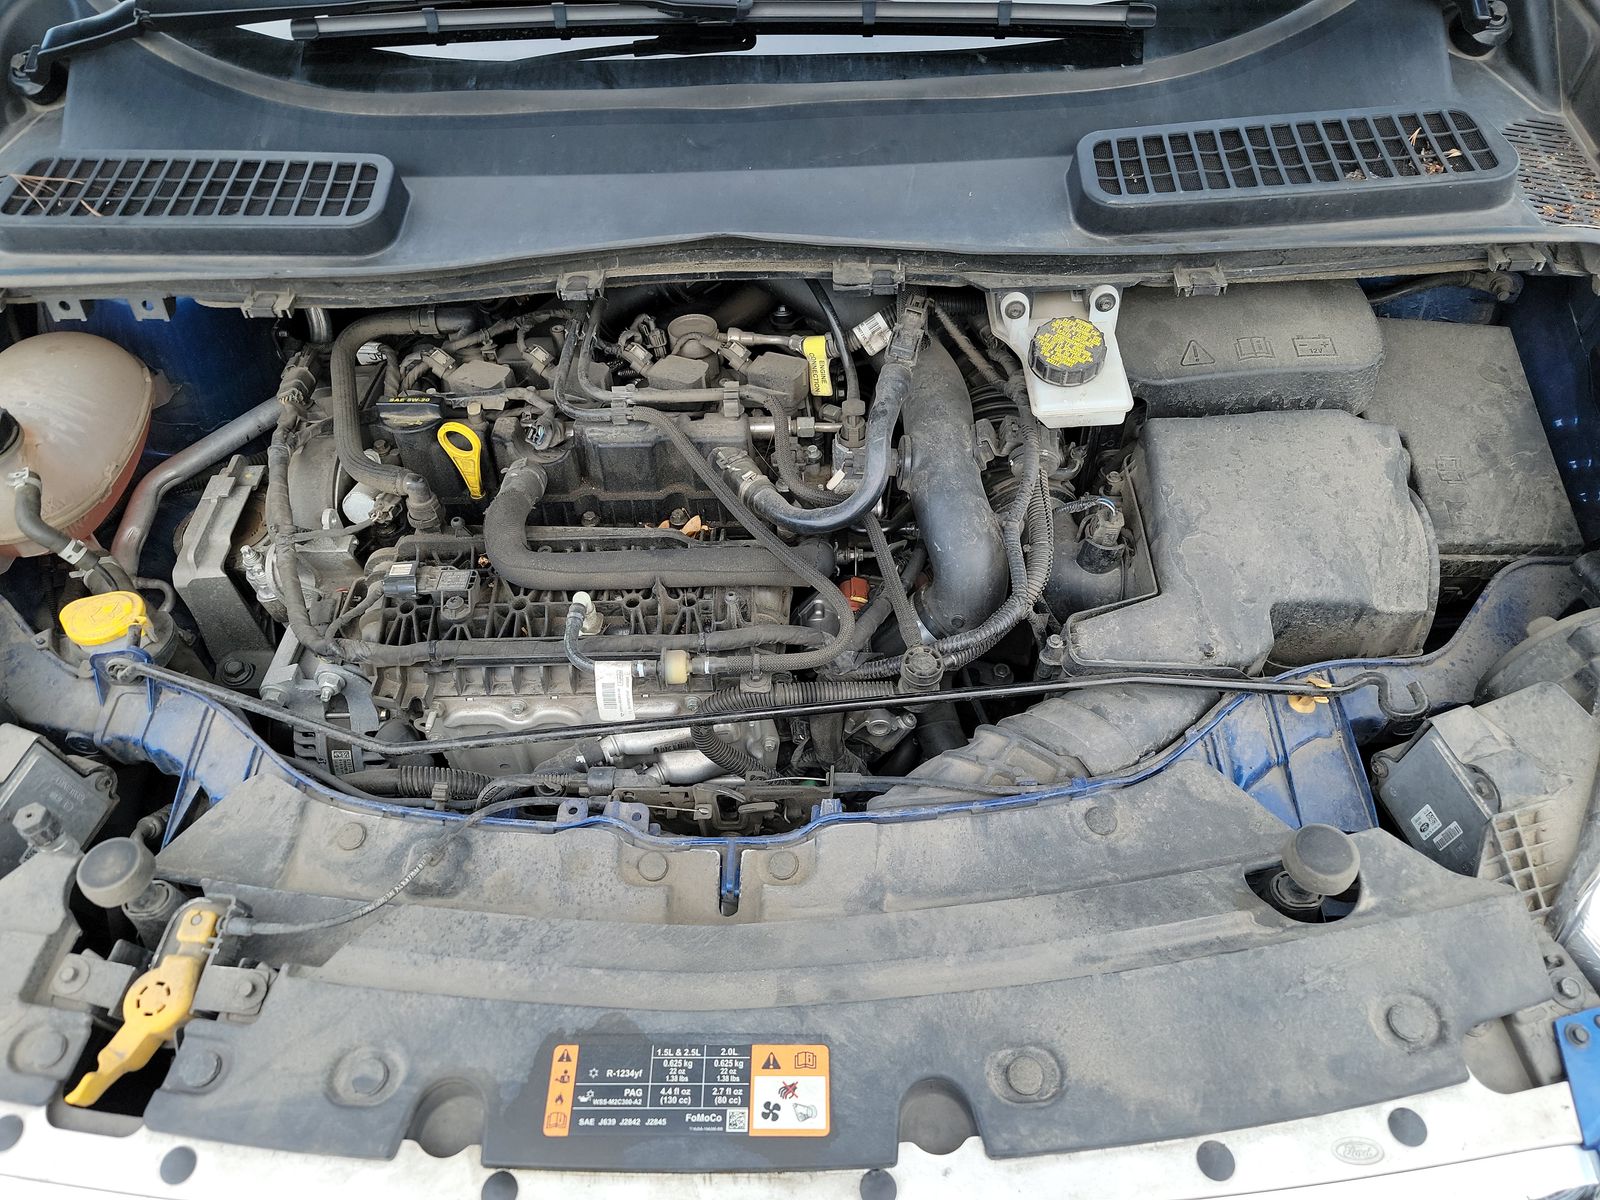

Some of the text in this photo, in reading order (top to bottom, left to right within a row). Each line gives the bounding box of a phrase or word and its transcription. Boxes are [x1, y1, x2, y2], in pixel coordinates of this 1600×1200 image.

[809, 352, 820, 392] CONNECTION
[819, 360, 828, 384] ENGINE
[657, 1048, 701, 1056] 1.5L & 2.5L
[720, 1047, 738, 1056] 2.0L
[663, 1059, 693, 1069] 0.625 kg
[713, 1059, 744, 1069] 0.625 kg
[606, 1069, 643, 1079] R-1234yf
[624, 1089, 643, 1097] PAG
[660, 1087, 672, 1095] 4.4
[673, 1087, 680, 1095] fl
[712, 1087, 724, 1095] 2.7
[725, 1087, 732, 1095] fl
[660, 1096, 692, 1105] (130 cc)
[714, 1096, 742, 1105] (80 cc)
[578, 1118, 595, 1126] SAE
[685, 1113, 722, 1122] FoMoCo
[1342, 1141, 1374, 1158] Ford
